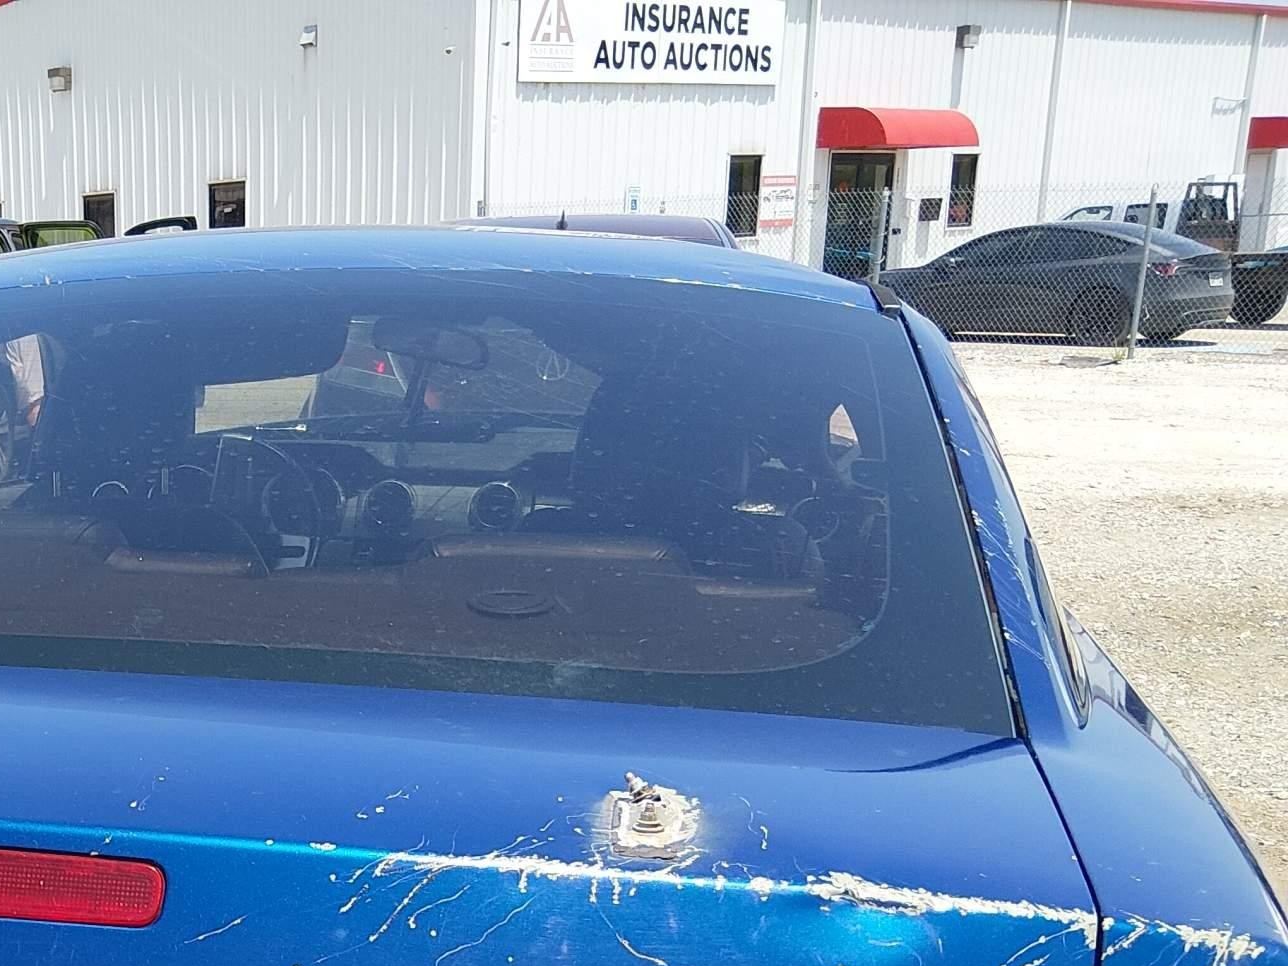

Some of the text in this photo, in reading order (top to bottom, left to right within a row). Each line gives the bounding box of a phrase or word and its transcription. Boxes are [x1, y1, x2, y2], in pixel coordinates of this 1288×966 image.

[624, 2, 750, 36] INSURANCE
[593, 39, 772, 72] AUTO AUCTIONS
